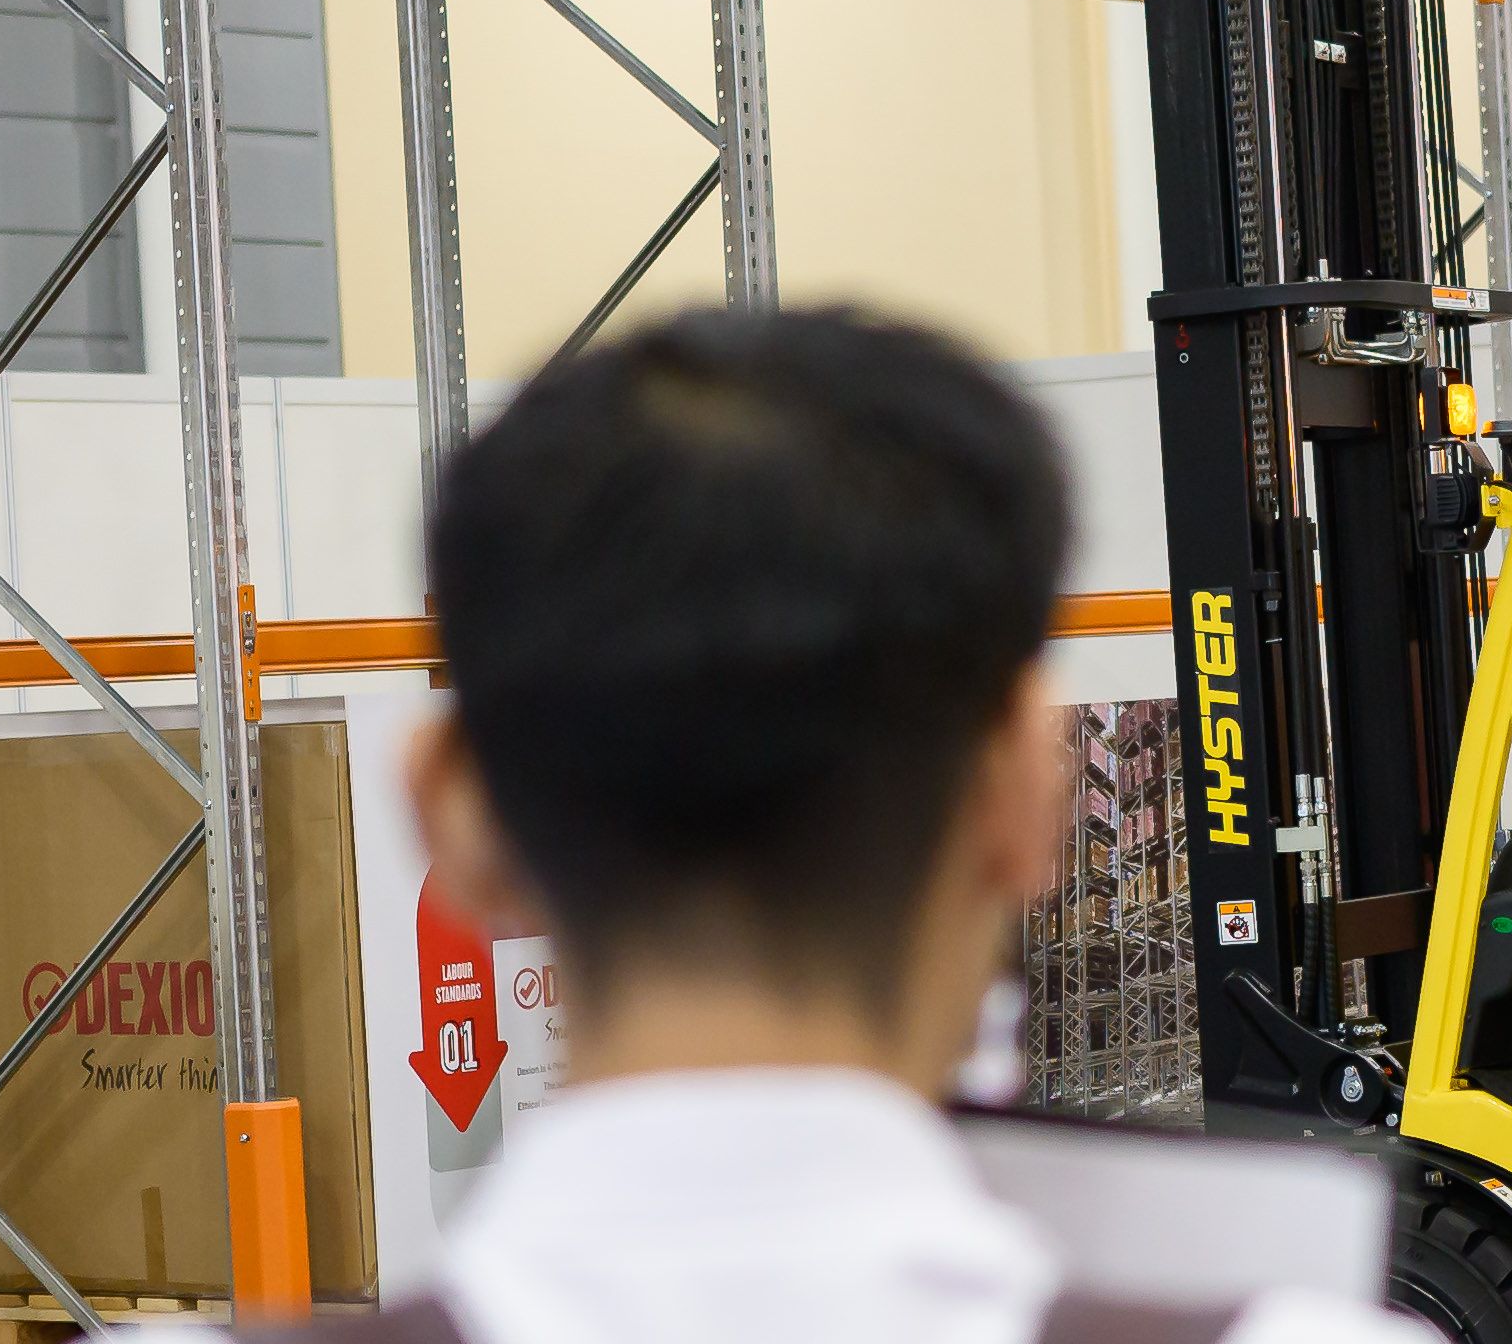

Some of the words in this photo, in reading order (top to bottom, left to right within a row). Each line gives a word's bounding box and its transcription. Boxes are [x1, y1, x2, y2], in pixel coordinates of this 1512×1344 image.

[1192, 590, 1250, 846] HYSTER
[441, 961, 473, 981] LABOUR
[435, 983, 482, 1004] STANDARDS
[439, 1017, 479, 1075] 01
[81, 1048, 168, 1092] Smarter
